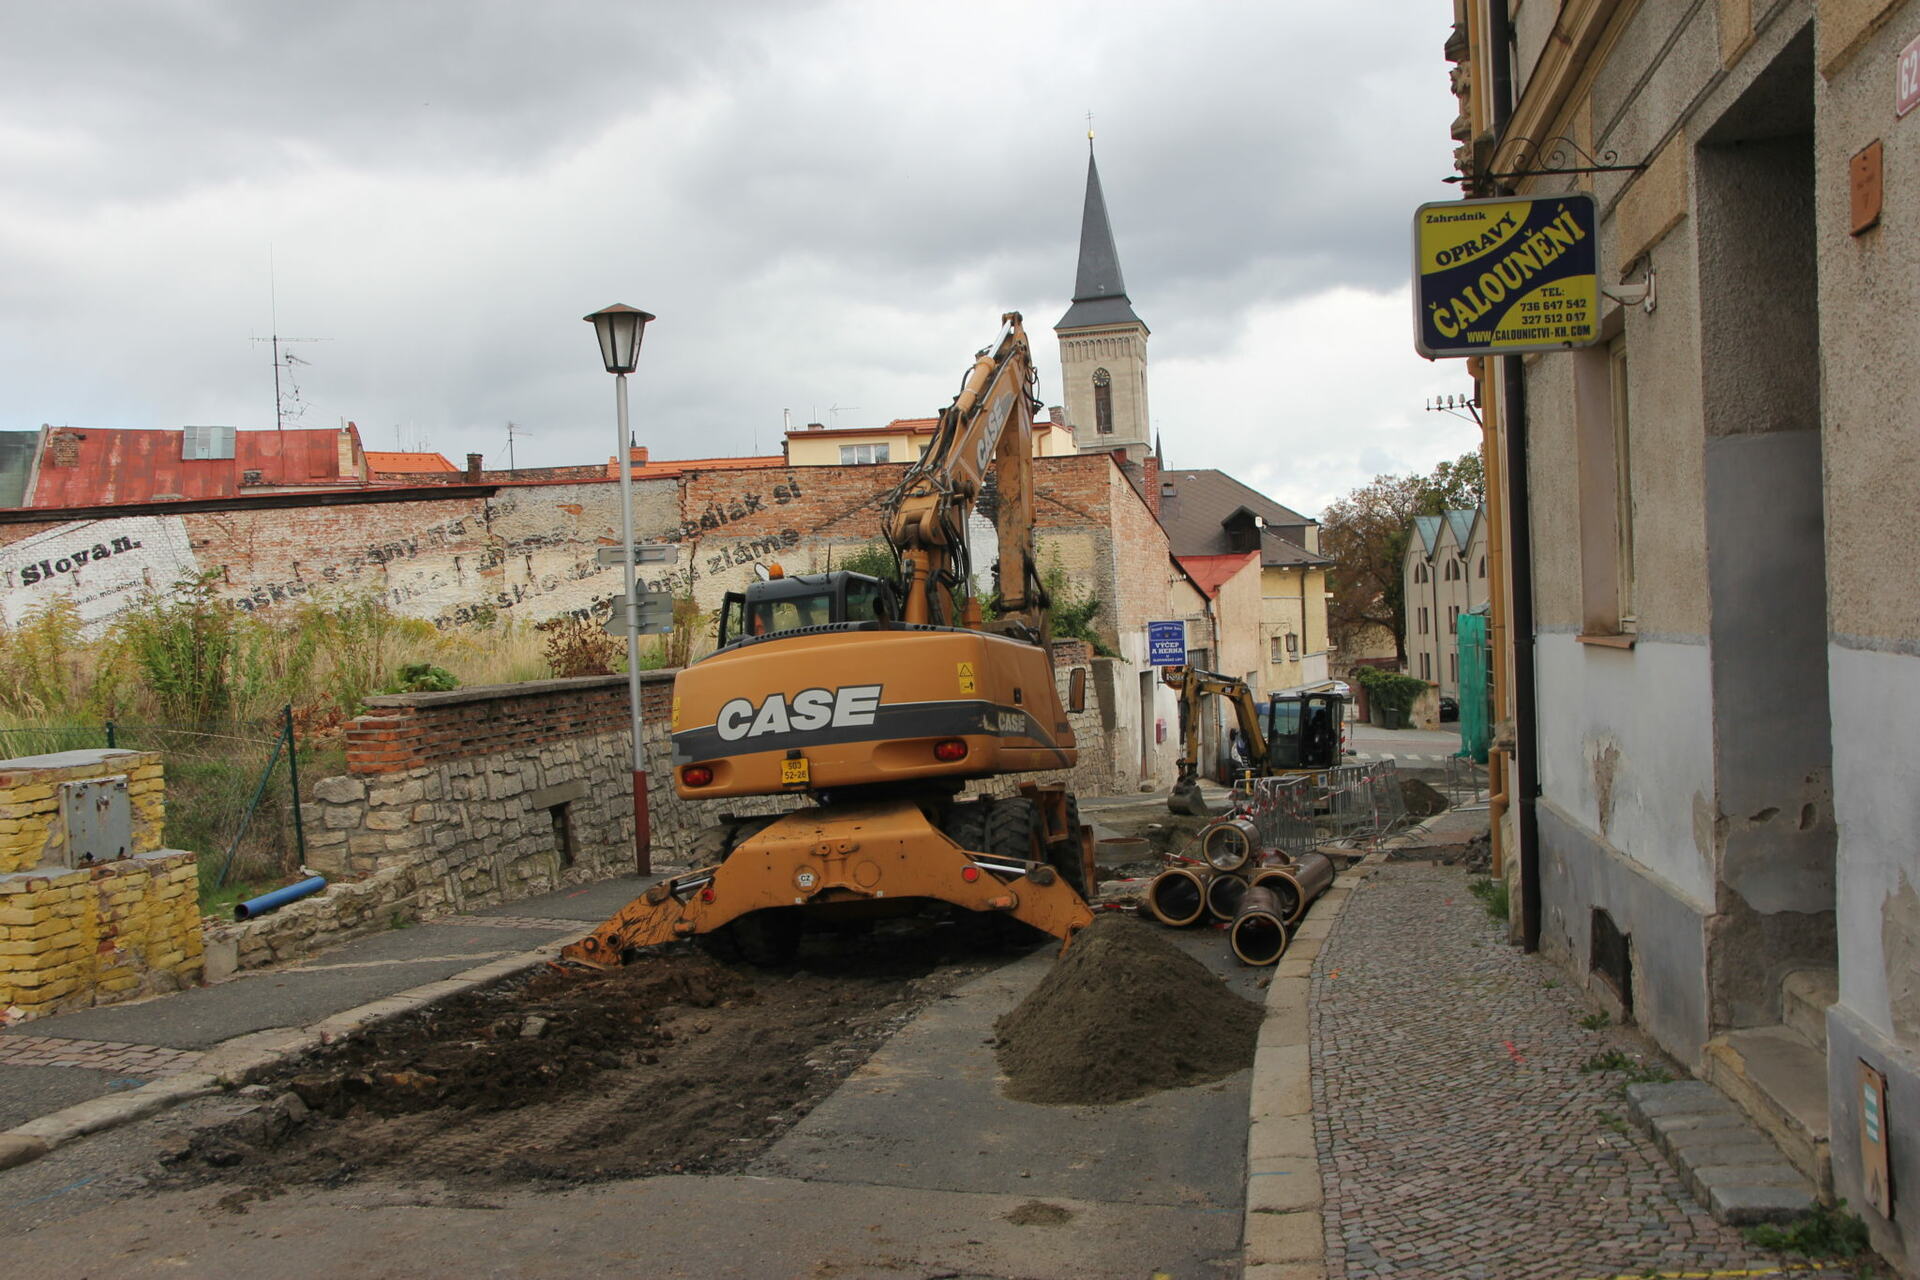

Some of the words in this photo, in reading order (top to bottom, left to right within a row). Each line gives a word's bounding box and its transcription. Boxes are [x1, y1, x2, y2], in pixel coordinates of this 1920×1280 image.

[1426, 212, 1487, 224] Zahradník
[1435, 211, 1518, 266] OPRAVY
[1428, 203, 1586, 338] ČALOUNĚNÍ
[1540, 288, 1565, 298] TEL:
[1520, 302, 1540, 312] 736
[1543, 301, 1563, 311] 647
[1566, 299, 1587, 309] 542
[1521, 315, 1541, 325] 327
[1544, 314, 1563, 323] 512
[1566, 313, 1586, 322] 017
[20, 535, 143, 586] Slovan.
[716, 684, 883, 741] CASE
[998, 712, 1025, 733] CASE
